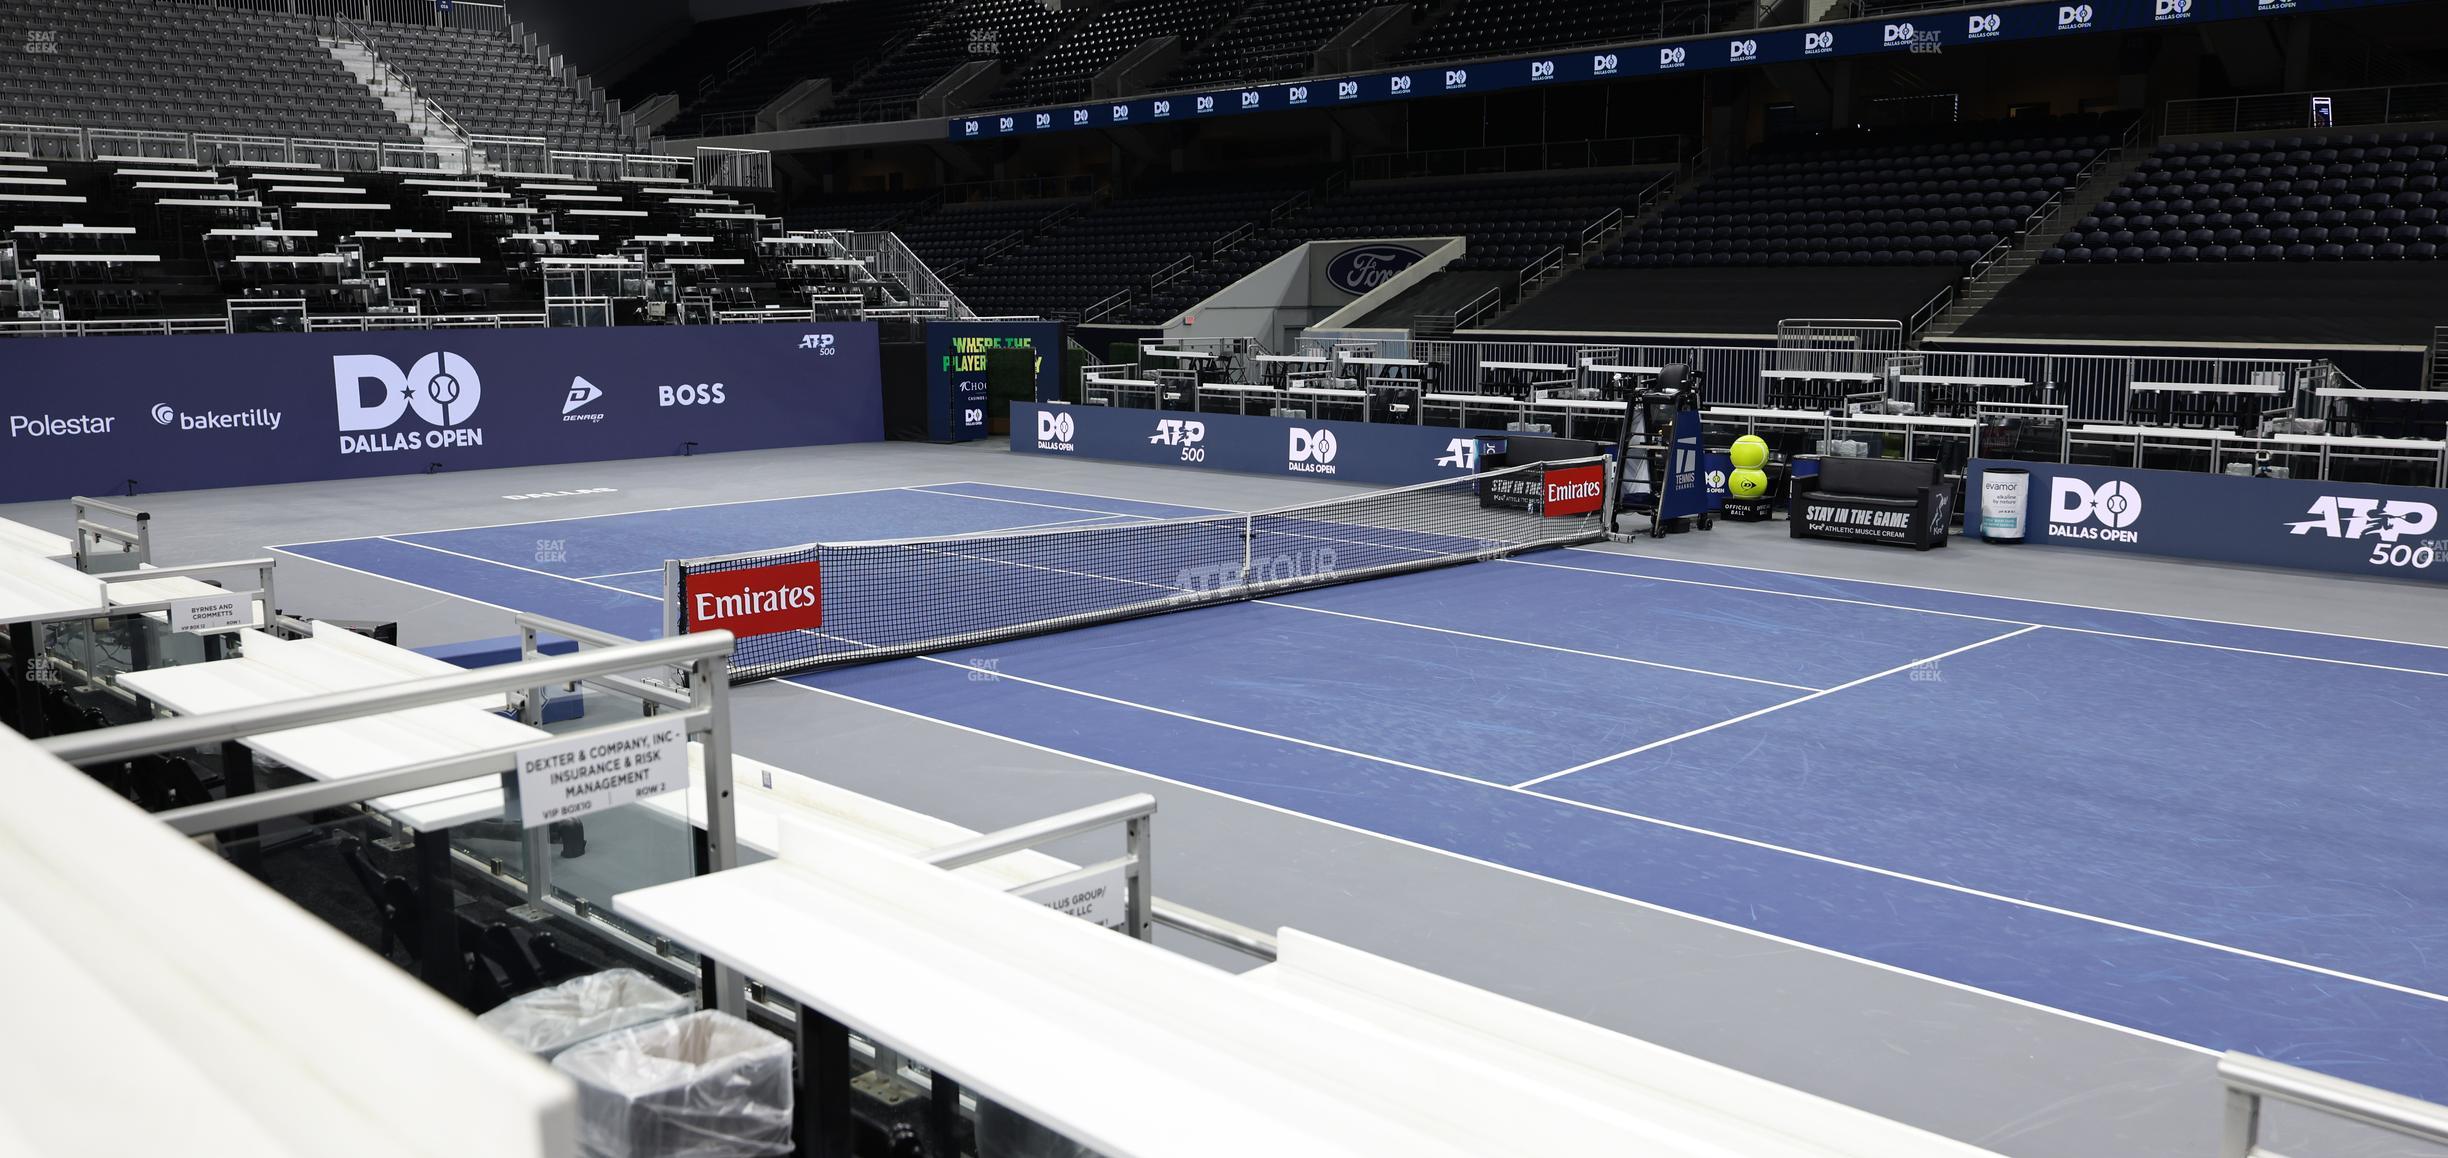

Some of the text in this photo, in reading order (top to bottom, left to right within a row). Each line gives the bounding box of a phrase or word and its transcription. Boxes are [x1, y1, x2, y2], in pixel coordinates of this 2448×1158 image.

[798, 334, 834, 349] ATP
[820, 348, 835, 356] 500
[659, 383, 726, 407] BOSS
[10, 414, 115, 438] Polestar
[180, 408, 282, 430] bakertilly
[563, 413, 604, 422] DENAGO
[340, 428, 483, 455] DALLAS OPEN
[1148, 419, 1205, 447] ATP
[1038, 440, 1074, 451] DALLAS OPEN
[1434, 438, 1474, 469] AT
[1180, 447, 1205, 463] 500
[1289, 462, 1336, 474] DALLAS OPEN
[1491, 479, 1513, 493] STAY
[1676, 472, 1695, 485] TENNIS
[1985, 482, 2017, 491] evamor
[501, 487, 619, 500] DALLAS
[1548, 480, 1601, 503] Emirates
[1806, 505, 1910, 529] STAY IN THE GAME
[2284, 495, 2438, 542] ATP
[1825, 525, 1854, 534] ATHLETIC
[1855, 528, 1881, 536] MUSCLE
[1882, 530, 1905, 538] CREAM
[2048, 523, 2138, 543] DALLAS OPEN
[2369, 543, 2434, 569] 500
[191, 605, 217, 613] BYRNES
[695, 584, 815, 622] Emirates
[192, 610, 233, 620] CROMMETTS
[525, 752, 575, 774] DEXTER
[577, 751, 586, 762] &
[590, 736, 650, 759] COMPANY,
[652, 730, 673, 744] INC
[550, 750, 662, 785] INSURANCE & RISK
[565, 768, 650, 798] MANAGEMENT
[635, 782, 666, 797] ROW 2
[542, 807, 558, 819] VIP
[1072, 885, 1107, 905] GROUP/
[1076, 903, 1093, 916] LLC
